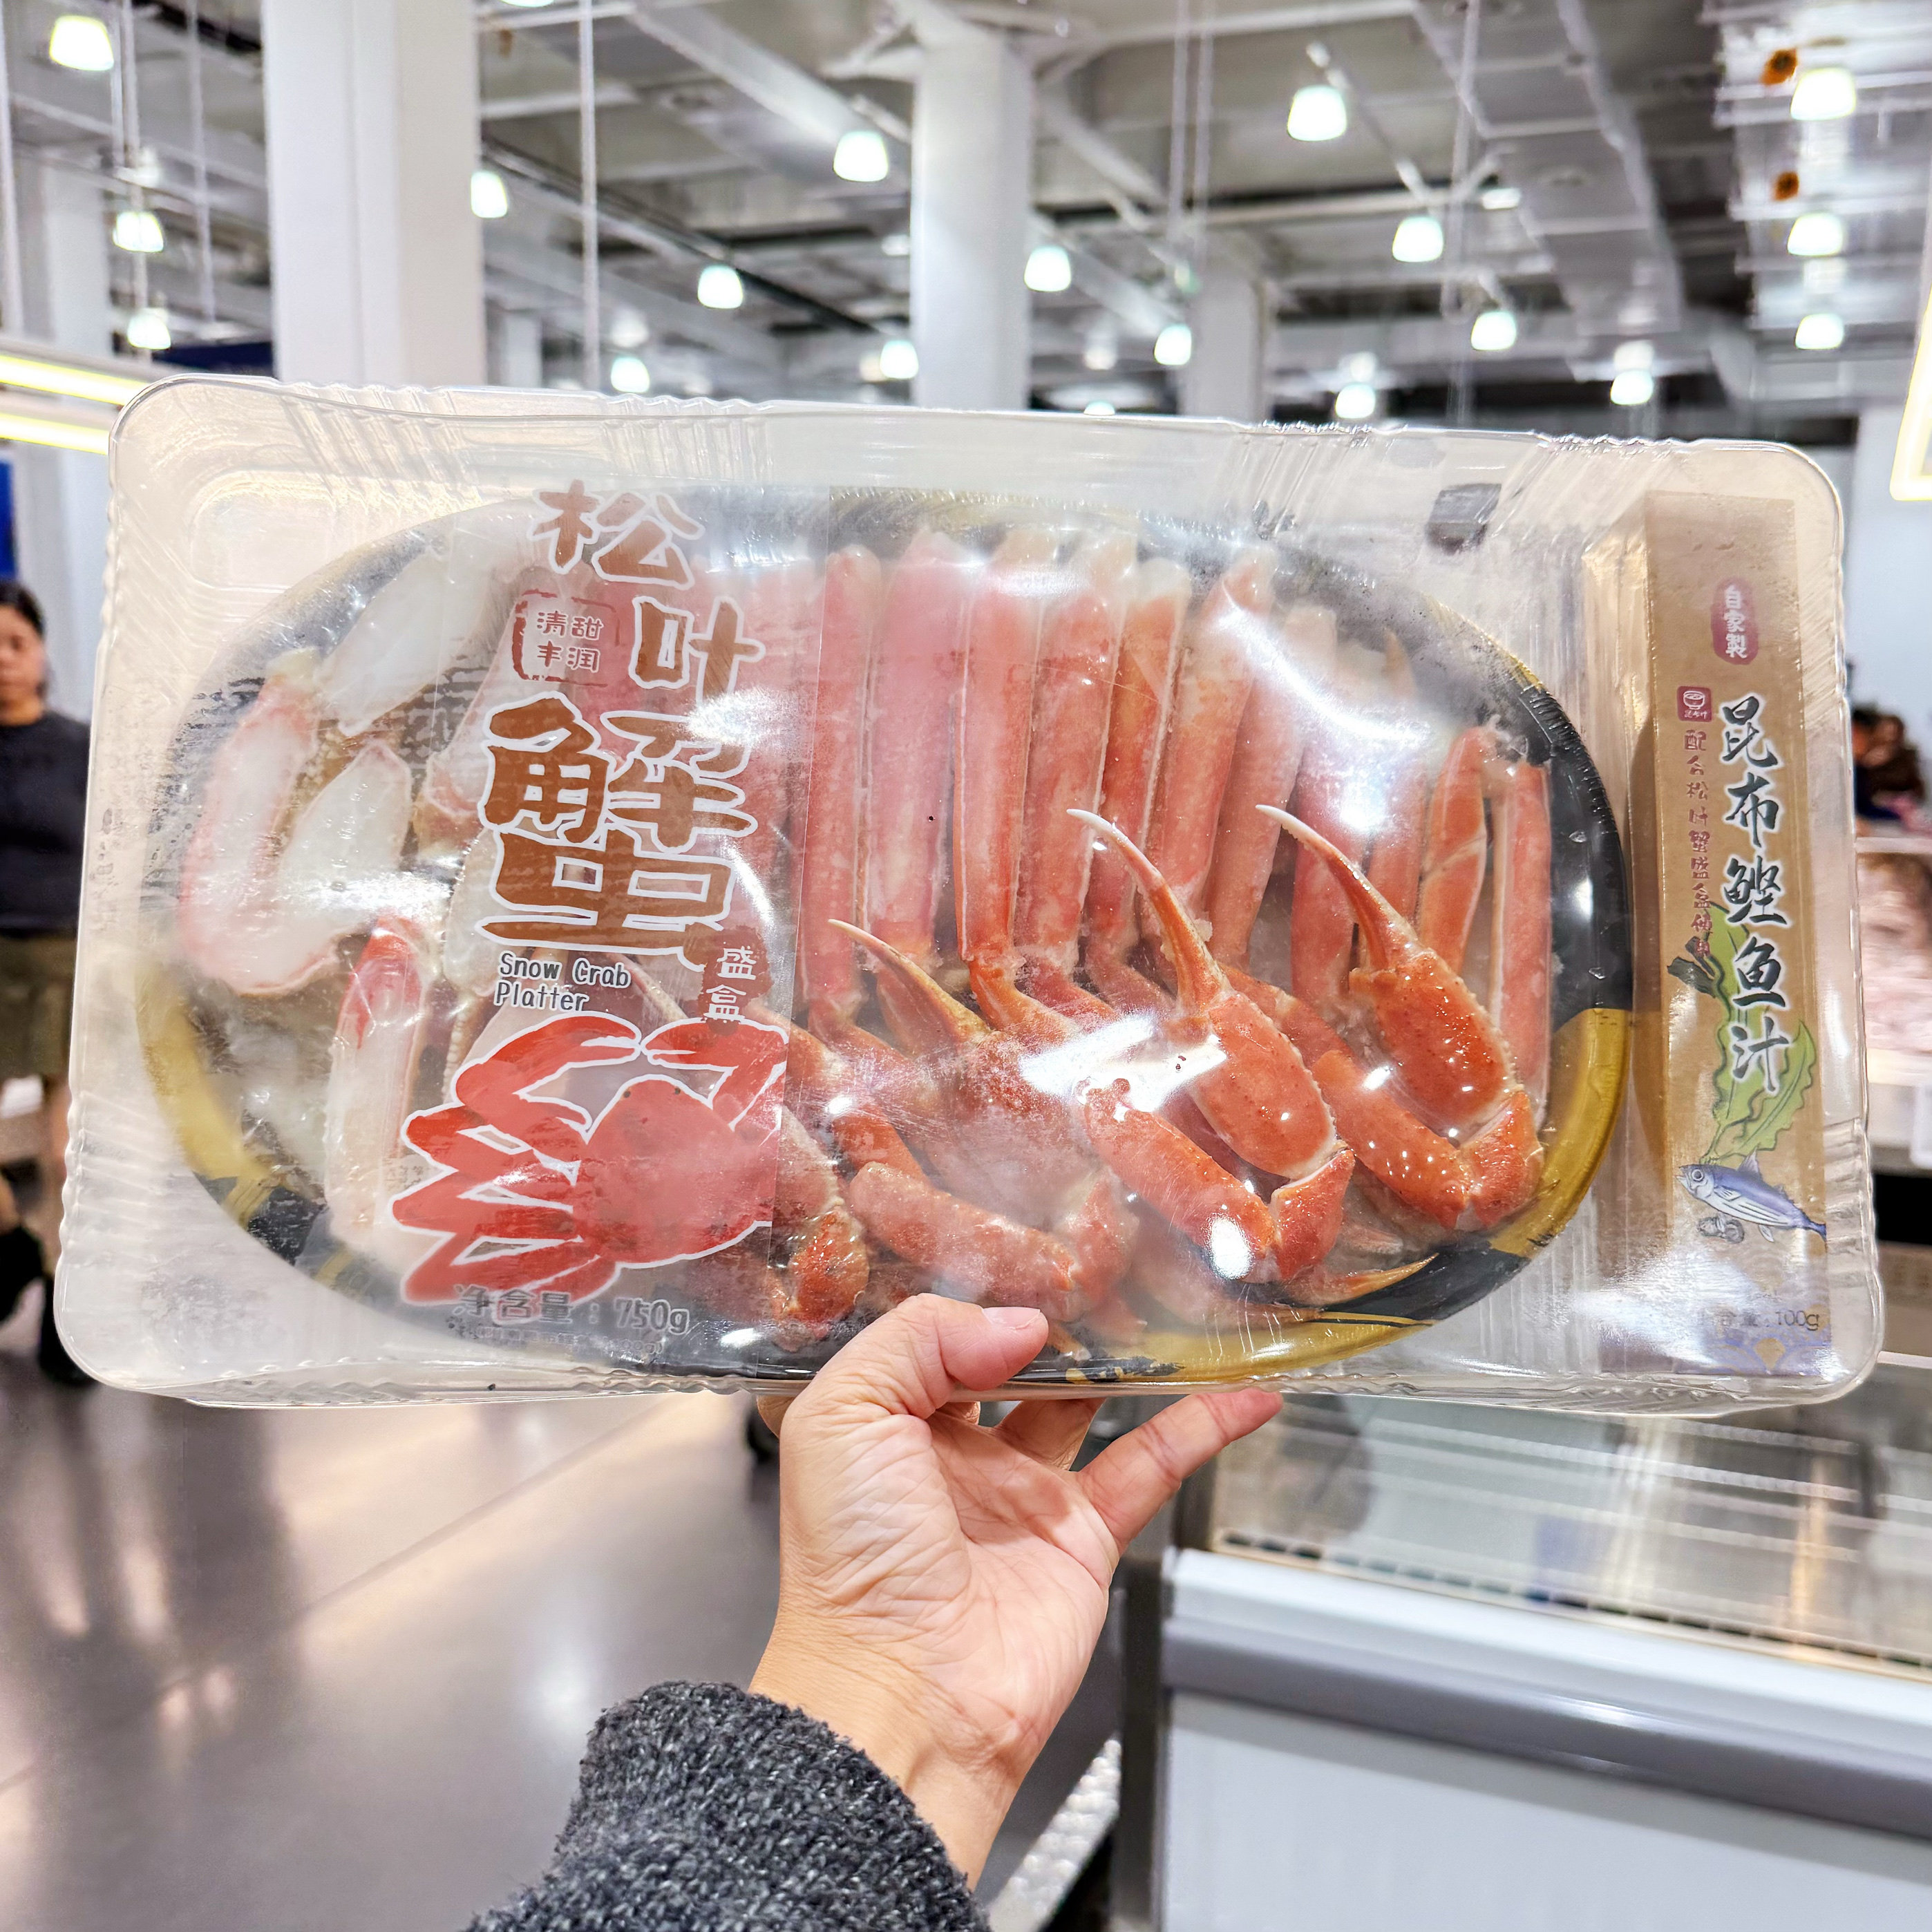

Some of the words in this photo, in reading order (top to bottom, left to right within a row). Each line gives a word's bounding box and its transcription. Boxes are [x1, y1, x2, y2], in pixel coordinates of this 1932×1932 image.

[536, 609, 605, 642] 清甜
[536, 640, 601, 674] 丰润
[477, 480, 765, 972] 松叶蟹
[1720, 693, 1790, 1094] 昆布鲣鱼汁
[498, 951, 562, 981] Snow
[573, 955, 632, 988] Crab
[705, 945, 757, 1023] 盛盒
[493, 981, 591, 1013] Platter
